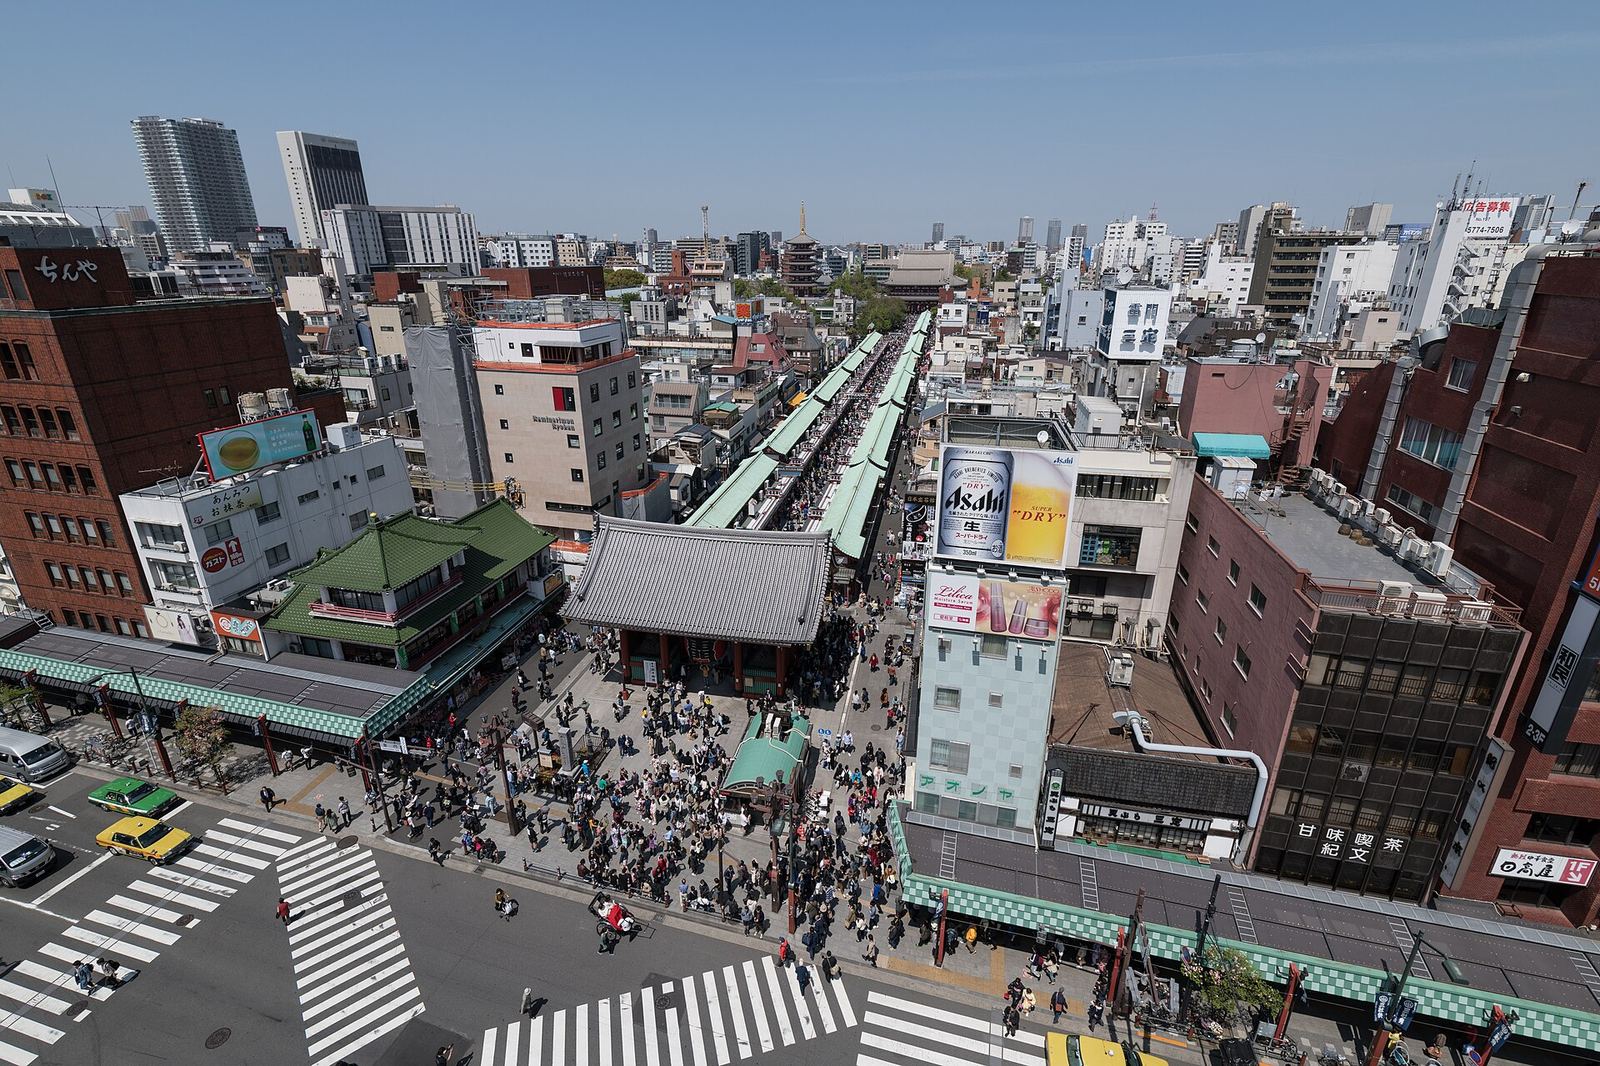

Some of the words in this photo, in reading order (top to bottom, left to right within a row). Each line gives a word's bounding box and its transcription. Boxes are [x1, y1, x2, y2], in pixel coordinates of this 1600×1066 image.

[1462, 201, 1511, 213] 広告募集
[34, 256, 98, 283] ちんや
[1127, 303, 1159, 321] 雷門
[1121, 328, 1159, 344] 三定
[532, 415, 575, 425] Kaminarimon
[552, 423, 576, 431] Ryokan
[1053, 456, 1073, 465] Asahi
[212, 486, 250, 505] あんみつ
[945, 486, 1005, 514] Asahi
[211, 499, 245, 516] お抹茶
[963, 521, 980, 532] 生
[955, 532, 988, 541] スーパードライ
[205, 556, 226, 568] ガスト
[934, 585, 973, 600] Lilica
[1551, 647, 1577, 686] 和民
[1108, 808, 1141, 821] 天ぷら
[1154, 815, 1182, 827] 三定
[1299, 823, 1404, 852] 甘味喫茶
[1320, 843, 1370, 862] 紀文
[1500, 860, 1555, 878] 日高屋
[1569, 861, 1591, 872] 1F
